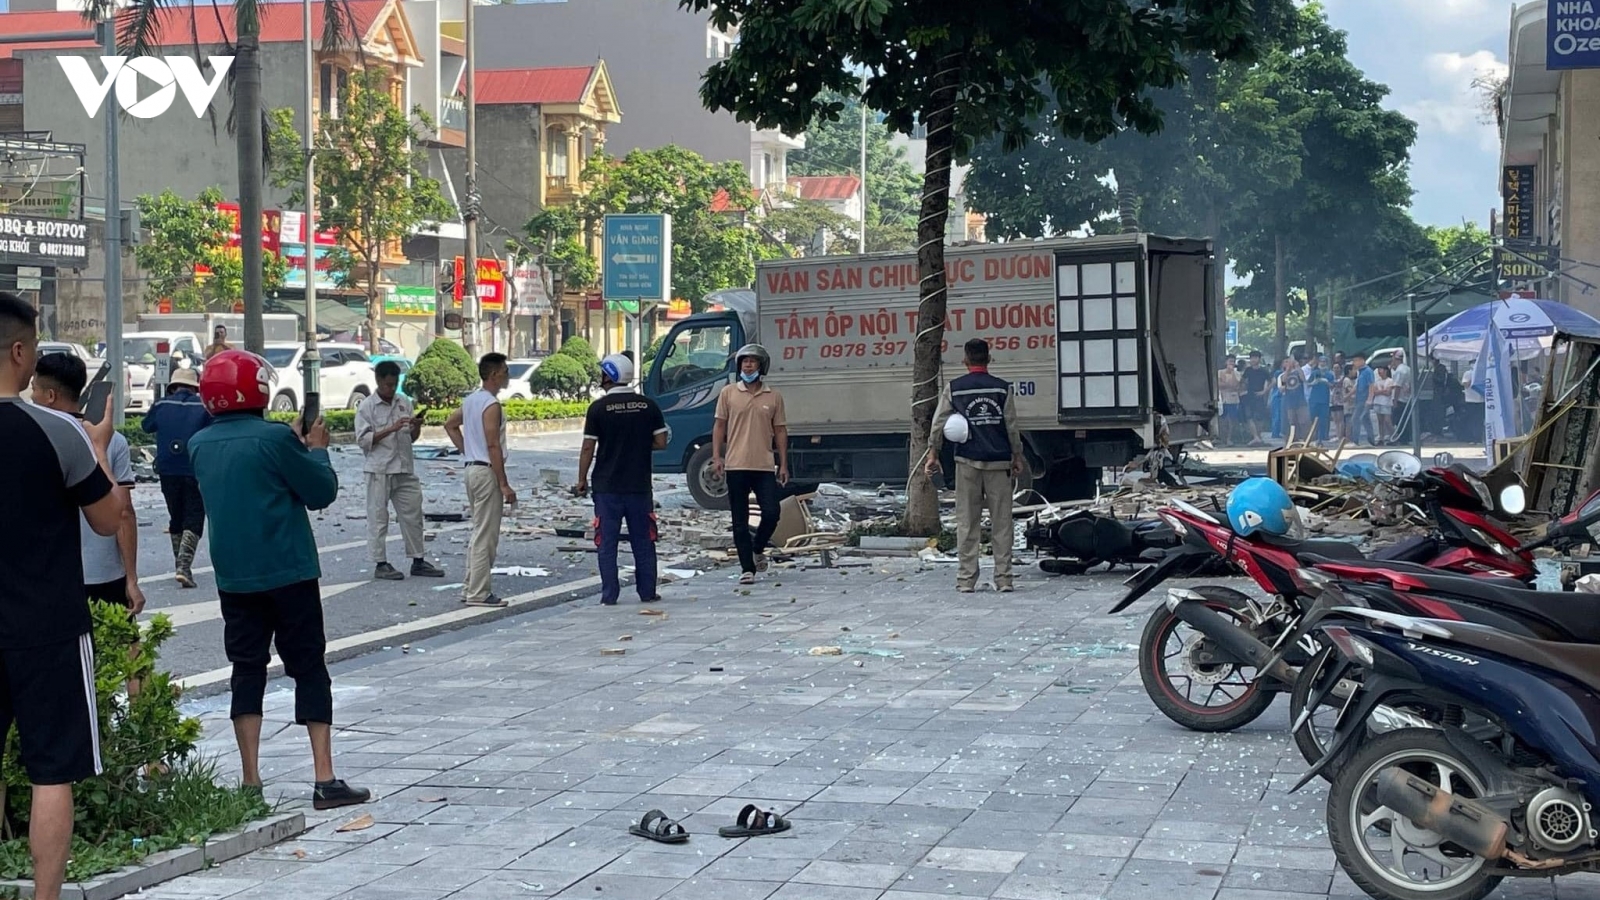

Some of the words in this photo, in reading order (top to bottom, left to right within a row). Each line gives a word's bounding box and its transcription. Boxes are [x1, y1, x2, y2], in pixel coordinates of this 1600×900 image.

[25, 220, 34, 235] &
[37, 221, 86, 238] HOTPOT
[632, 235, 659, 245] GIANG
[766, 267, 809, 294] VÁN
[869, 262, 919, 291] CHỊU
[946, 257, 975, 288] ỰC
[984, 254, 1054, 281] DƯƠN
[775, 308, 819, 339] TẤM
[825, 306, 853, 338] ỐP
[860, 307, 898, 340] NỘI
[975, 303, 1055, 330] DƯƠNG
[783, 346, 807, 360] ĐT
[820, 343, 867, 358] 0978
[872, 341, 908, 356] 397
[1408, 642, 1480, 665] VISION
